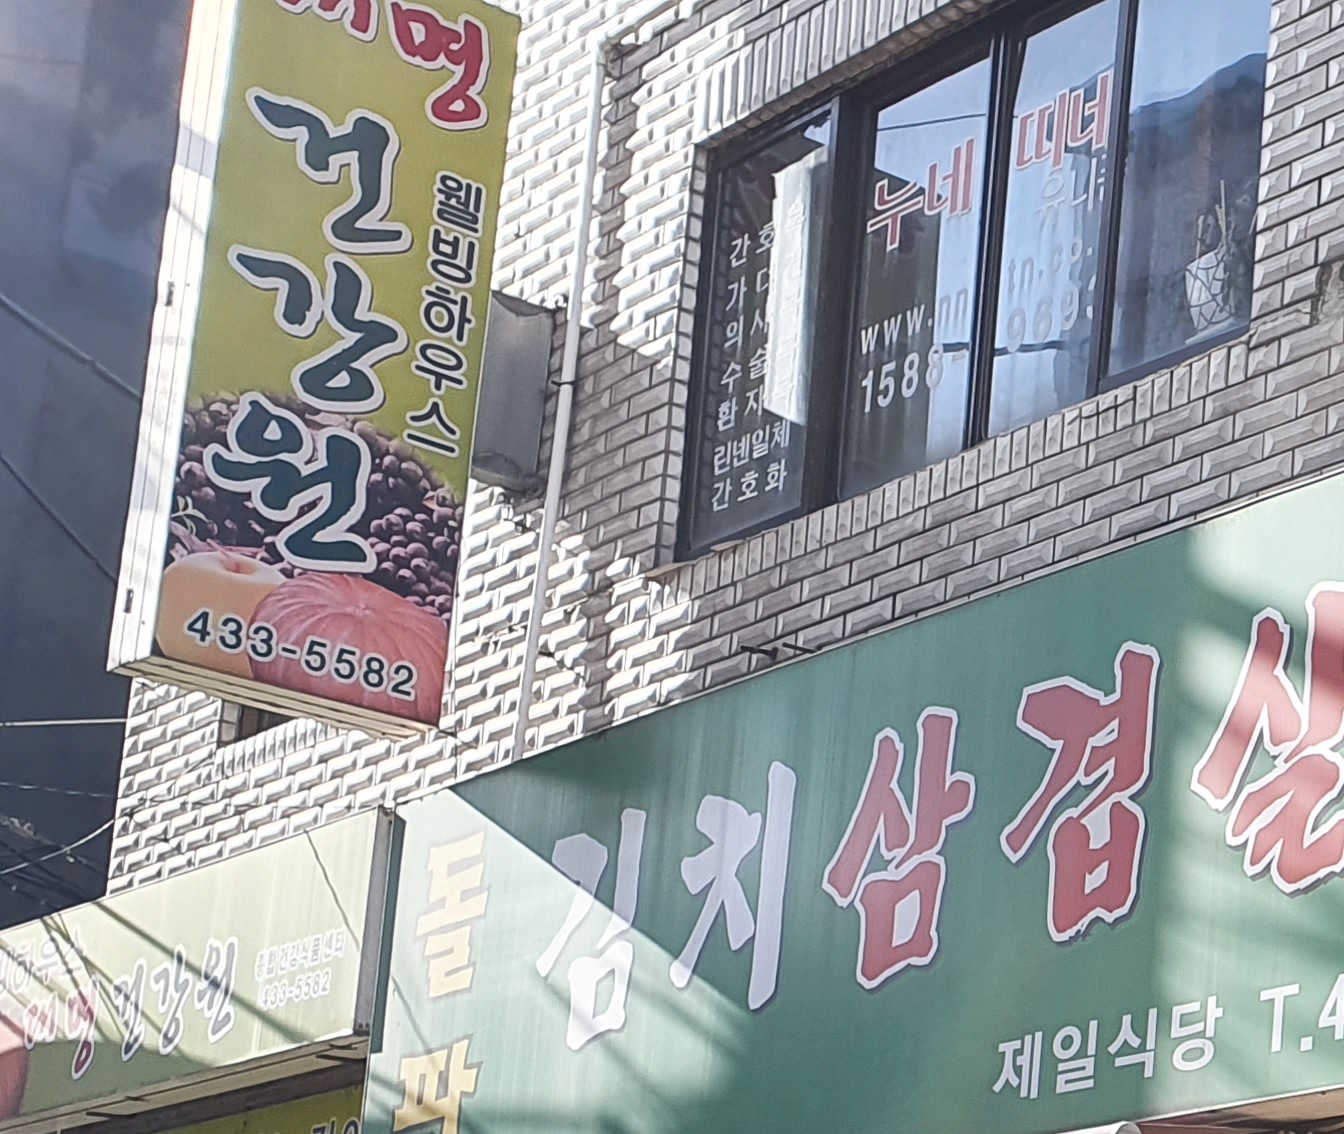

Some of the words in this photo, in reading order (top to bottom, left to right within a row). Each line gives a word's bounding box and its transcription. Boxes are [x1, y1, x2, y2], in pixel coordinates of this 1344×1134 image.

[205, 90, 412, 572] 건강원
[405, 170, 485, 457] 웰빙하우스
[711, 457, 788, 512] 간호화
[185, 609, 417, 699] 433-5582
[992, 996, 1223, 1100] 제일식당
